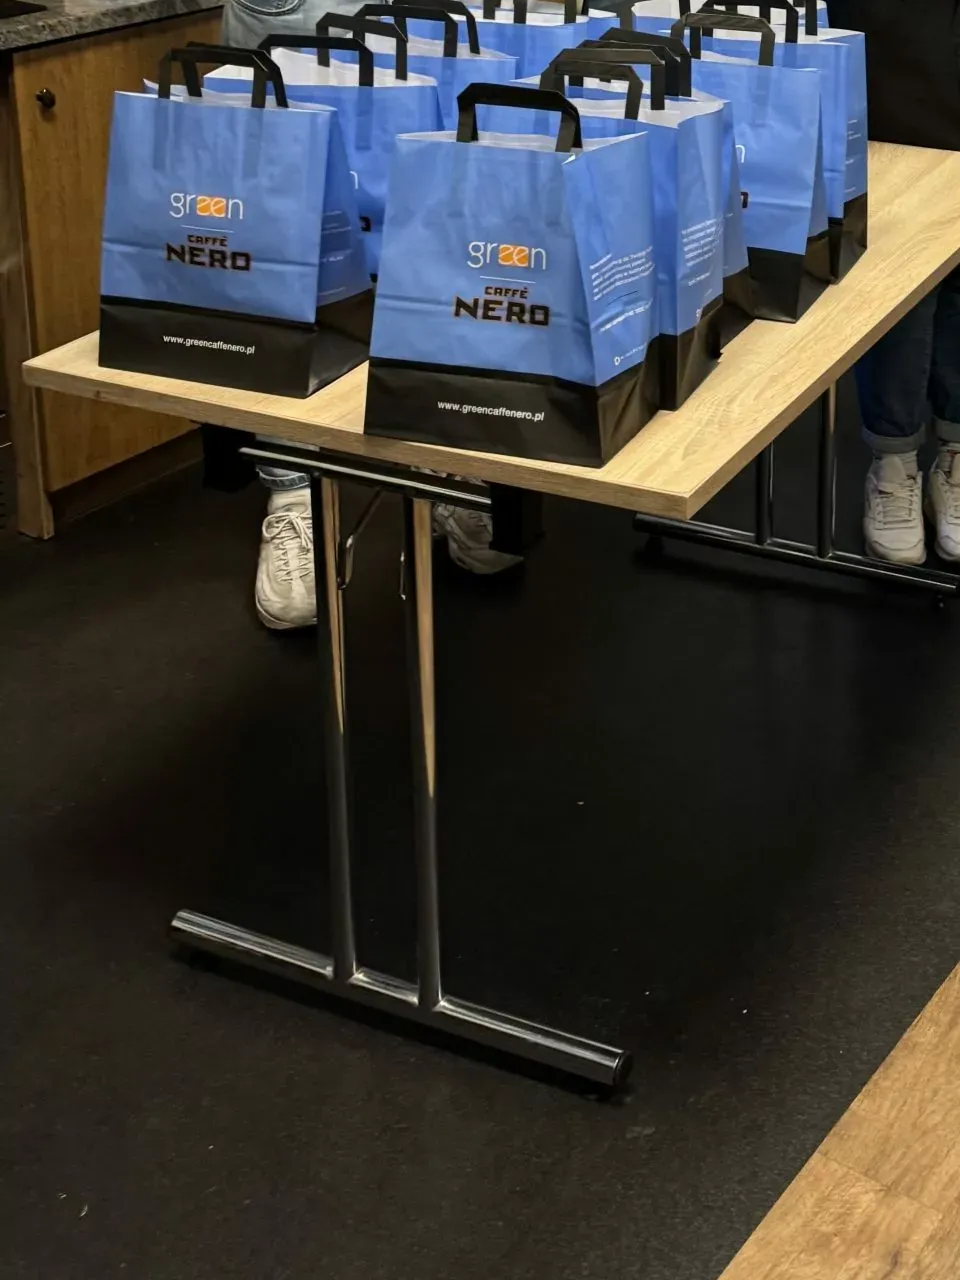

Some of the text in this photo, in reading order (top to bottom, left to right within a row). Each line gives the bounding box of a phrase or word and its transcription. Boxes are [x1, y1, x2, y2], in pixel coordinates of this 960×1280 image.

[169, 192, 244, 220] green
[165, 242, 252, 271] NERO
[467, 240, 546, 271] green
[454, 295, 550, 327] NERO
[163, 334, 255, 355] www.greencaffenero.pl
[437, 400, 545, 422] www.greencaffenero.pl
